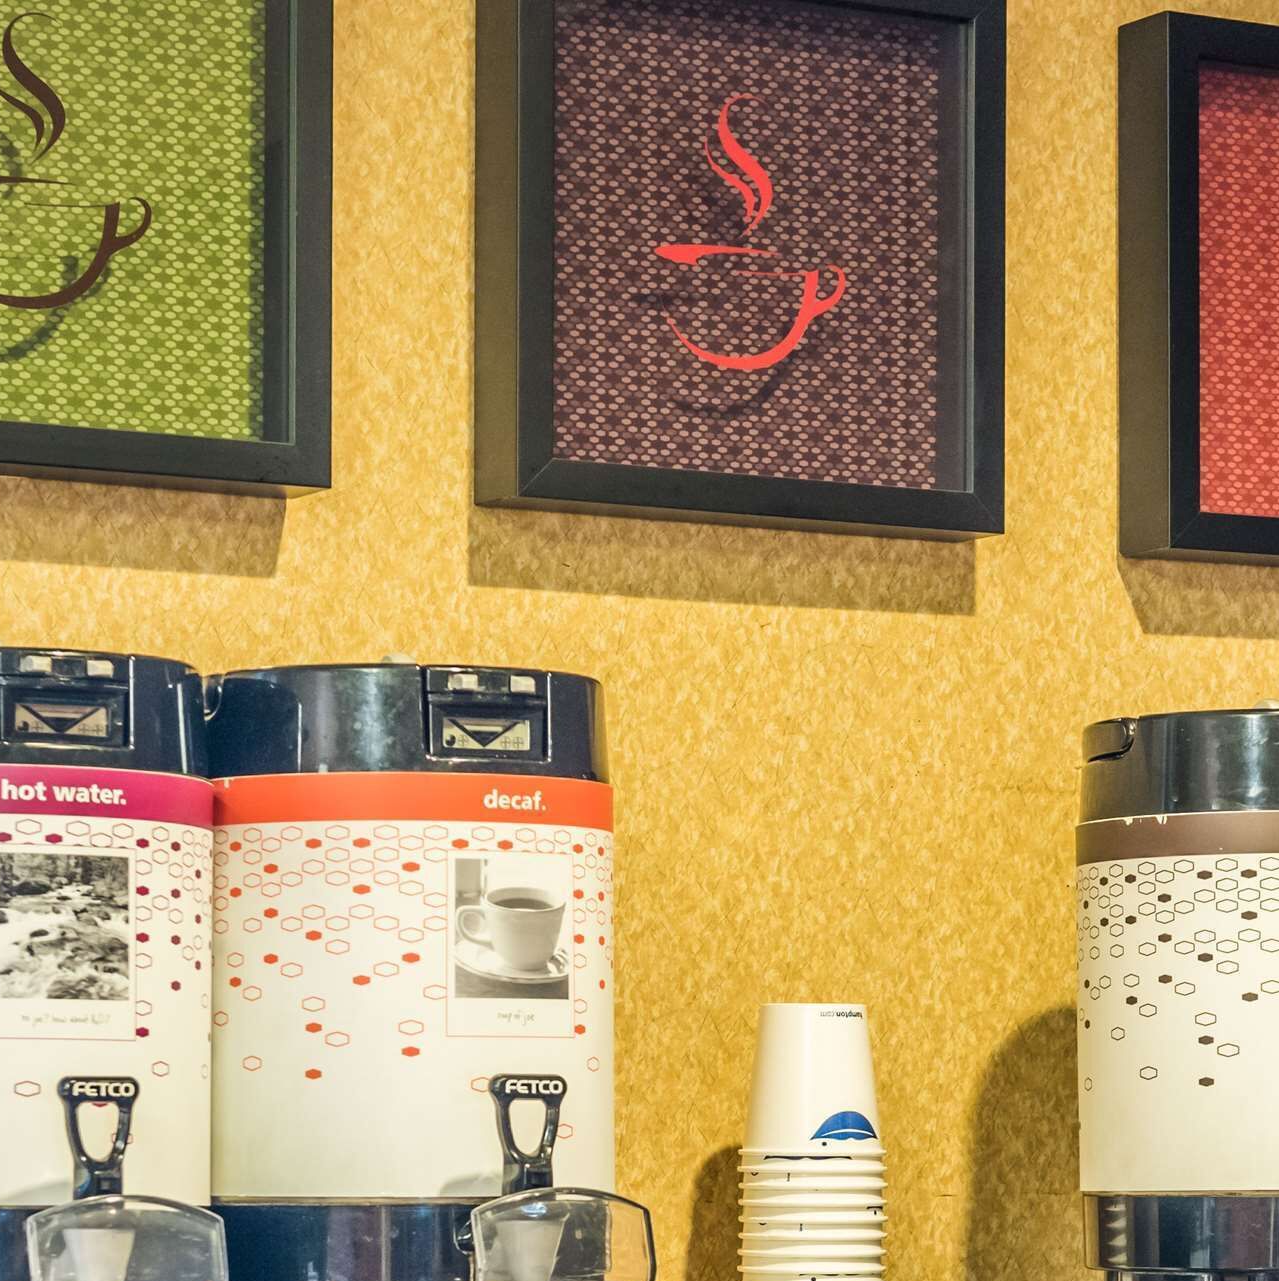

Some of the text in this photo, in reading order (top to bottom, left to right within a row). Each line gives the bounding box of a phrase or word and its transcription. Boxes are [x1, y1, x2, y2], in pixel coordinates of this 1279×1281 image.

[1, 778, 127, 805] hot water.
[483, 788, 547, 812] decaf.
[72, 1081, 136, 1097] FETCO
[505, 1079, 563, 1094] FETCO
